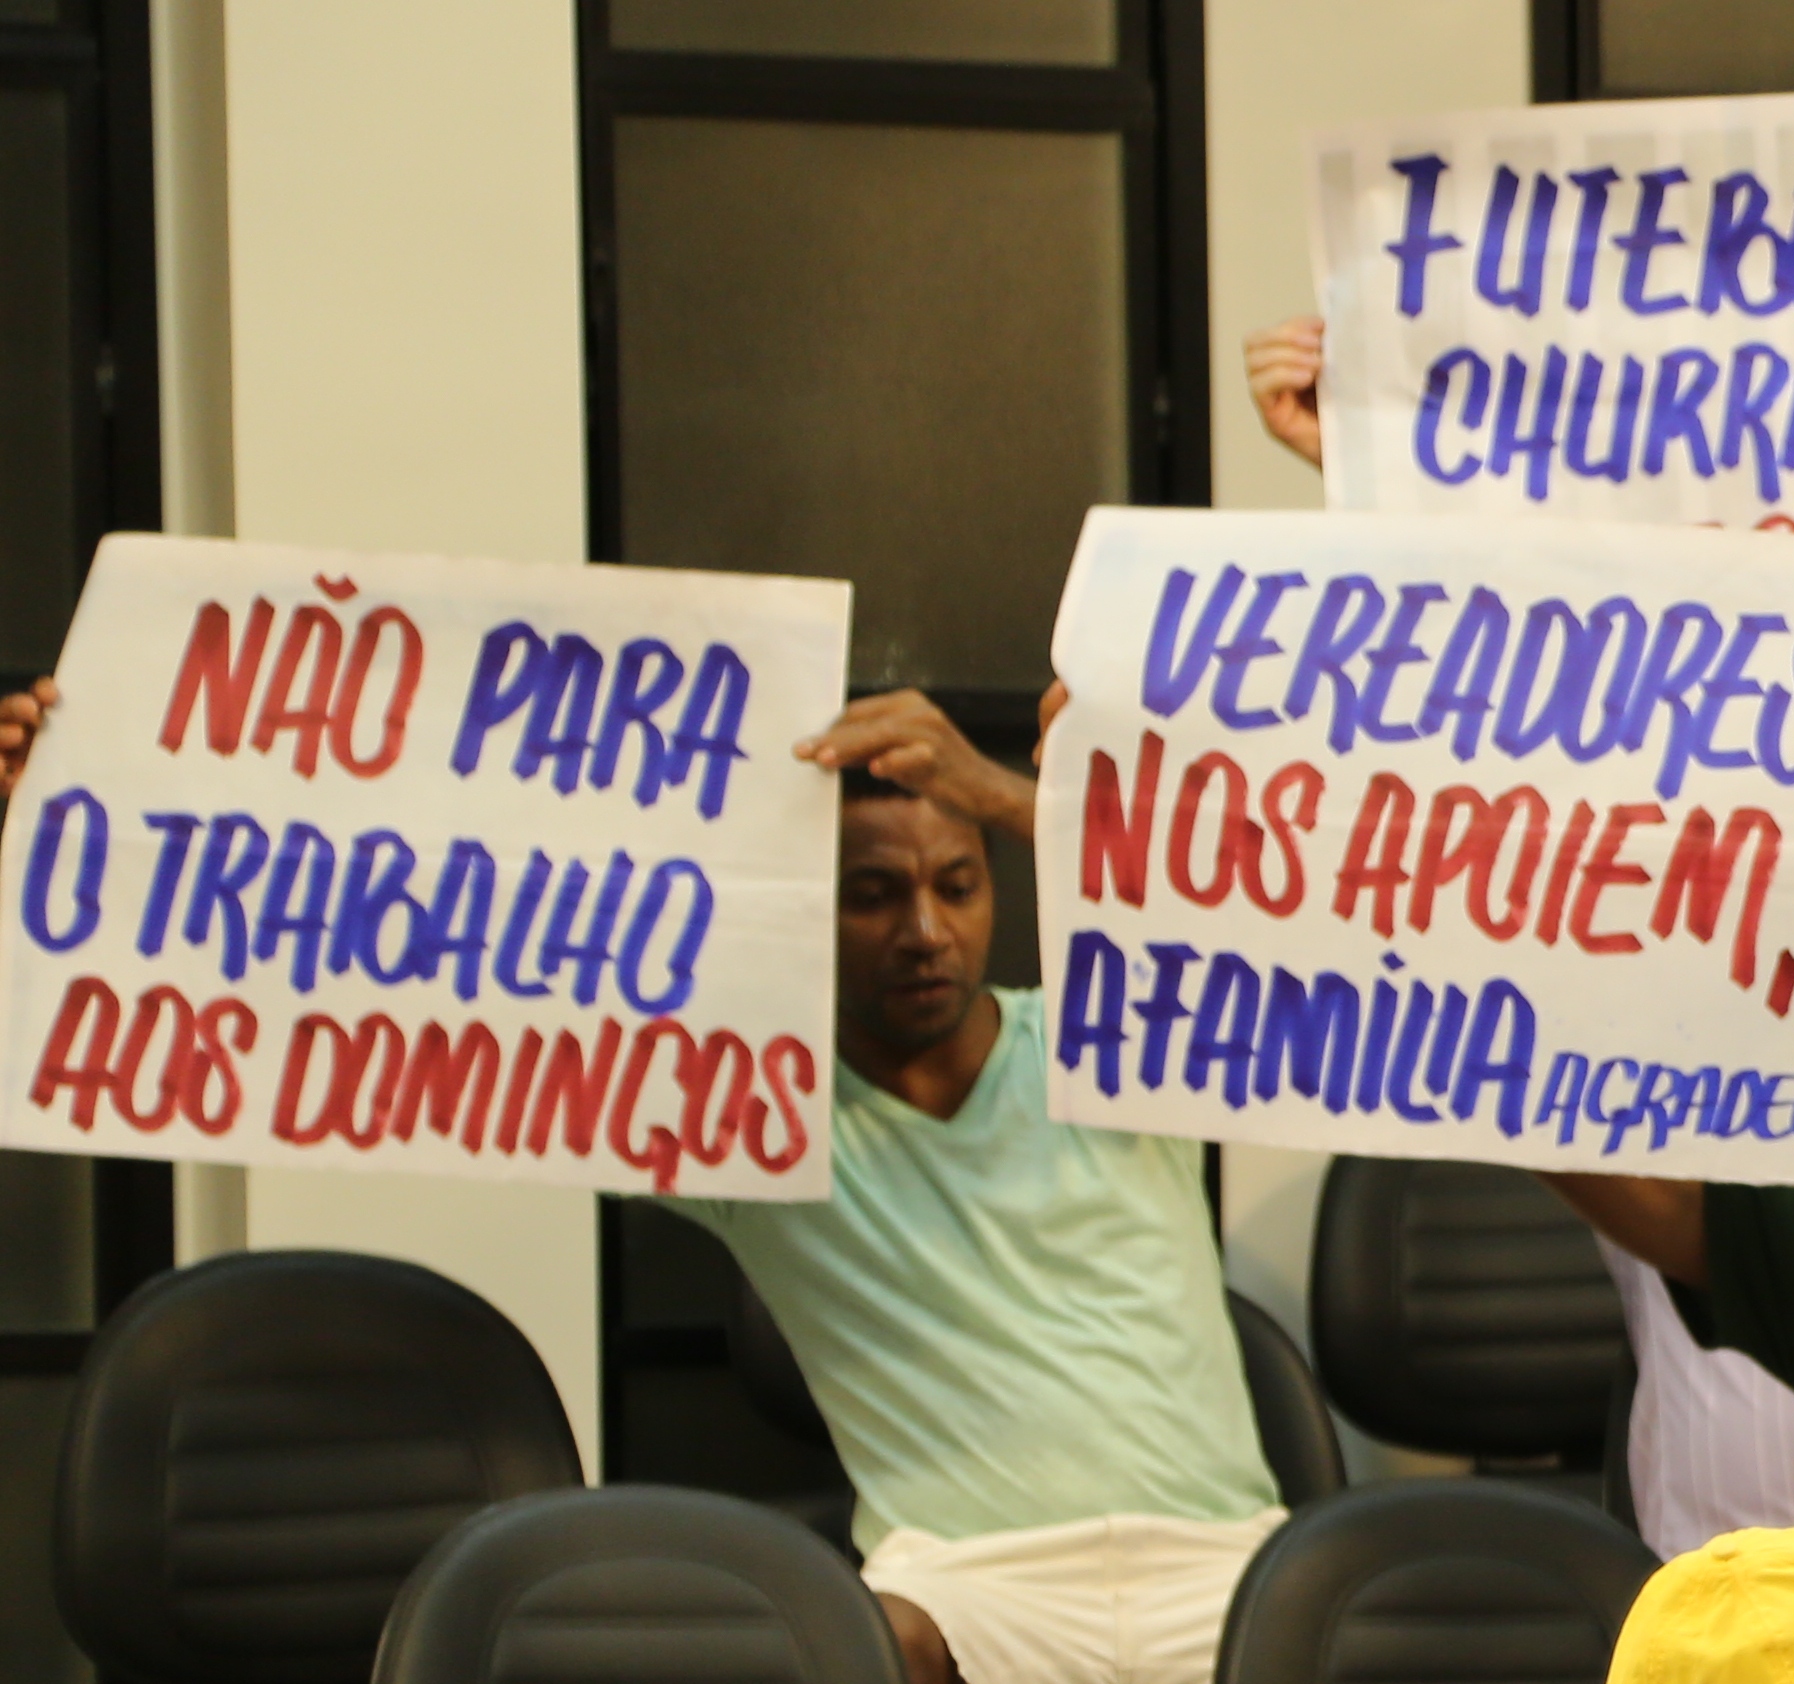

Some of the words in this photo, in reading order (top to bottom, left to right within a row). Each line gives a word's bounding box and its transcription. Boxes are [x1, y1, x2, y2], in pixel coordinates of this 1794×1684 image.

[158, 572, 424, 780] NÃO
[450, 620, 752, 822] PARA
[20, 786, 110, 953] O
[137, 811, 714, 1018] TRABALHO
[1079, 728, 1325, 918] NOS
[29, 976, 258, 1138] AOS
[271, 1016, 817, 1195] DOMINGOS
